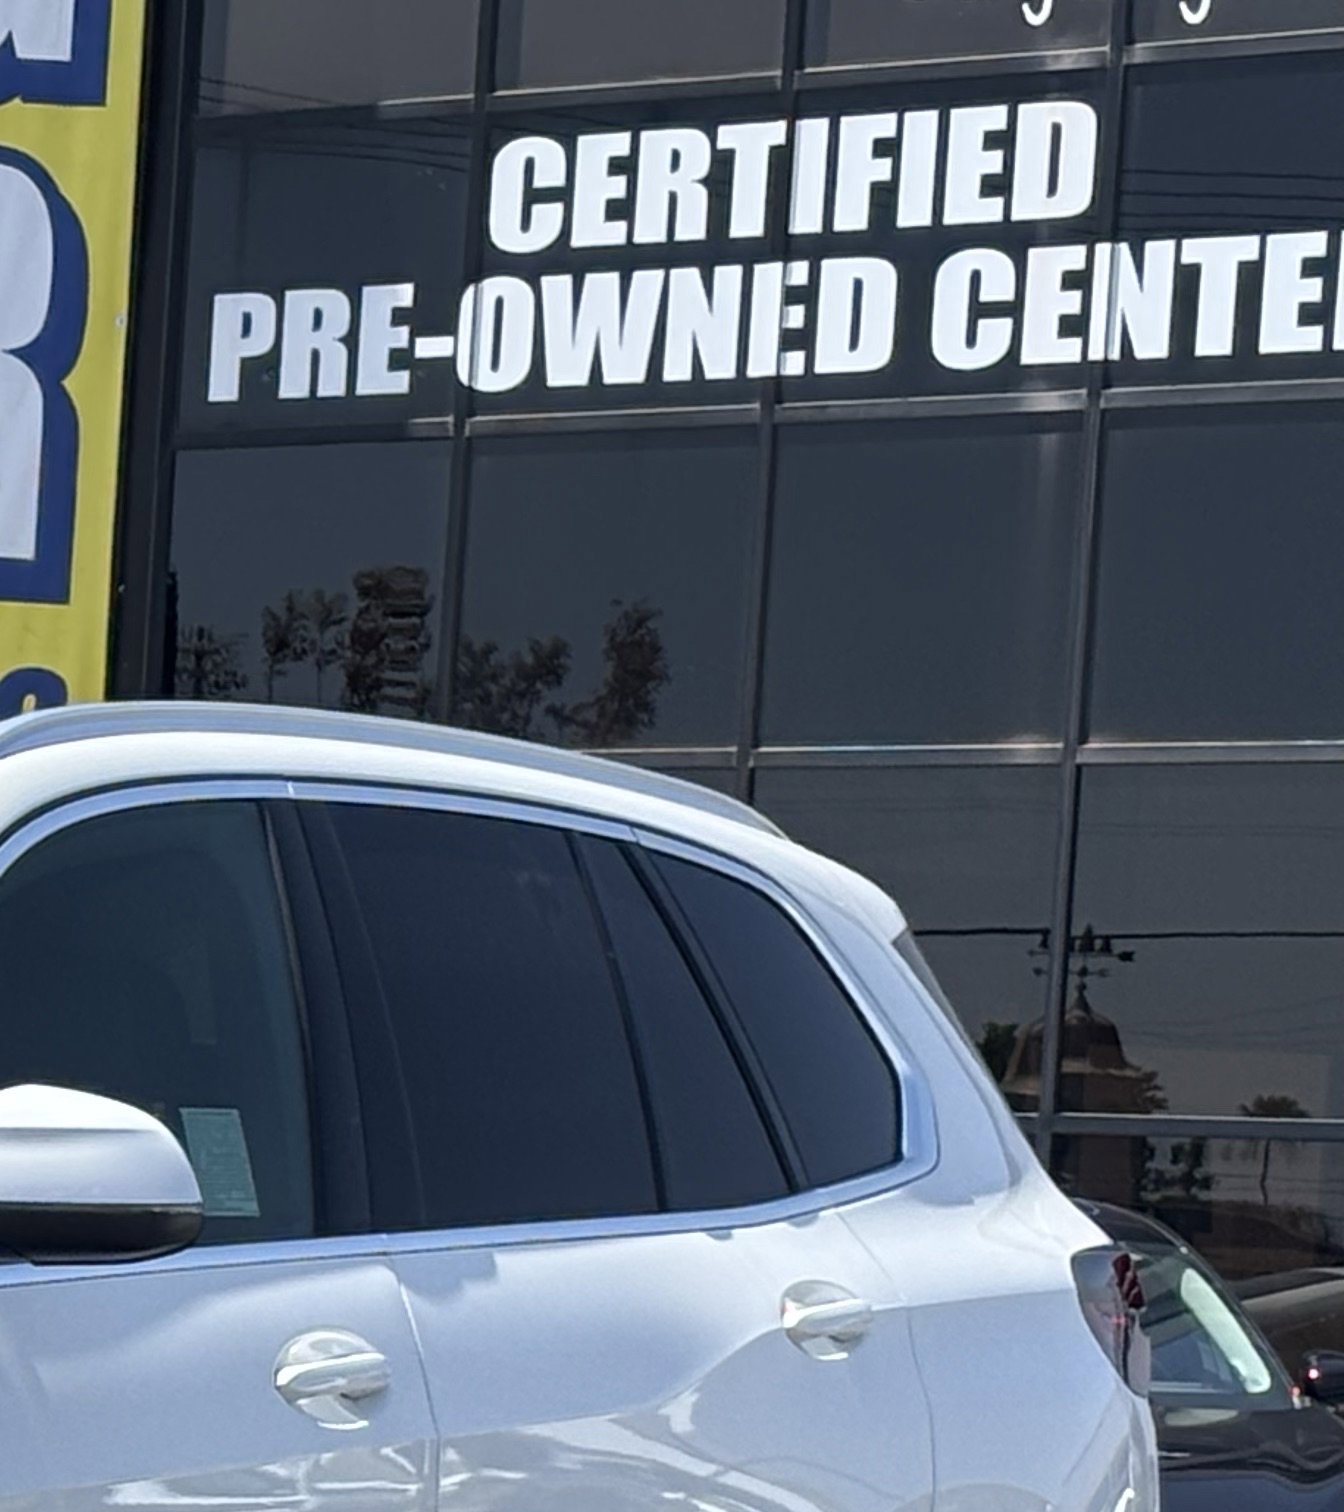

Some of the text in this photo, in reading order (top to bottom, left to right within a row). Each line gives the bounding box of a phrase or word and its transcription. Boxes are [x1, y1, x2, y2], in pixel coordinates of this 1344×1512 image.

[488, 100, 1099, 254] CERTIFIED
[207, 230, 1344, 402] PRE-OWNED CENTE
